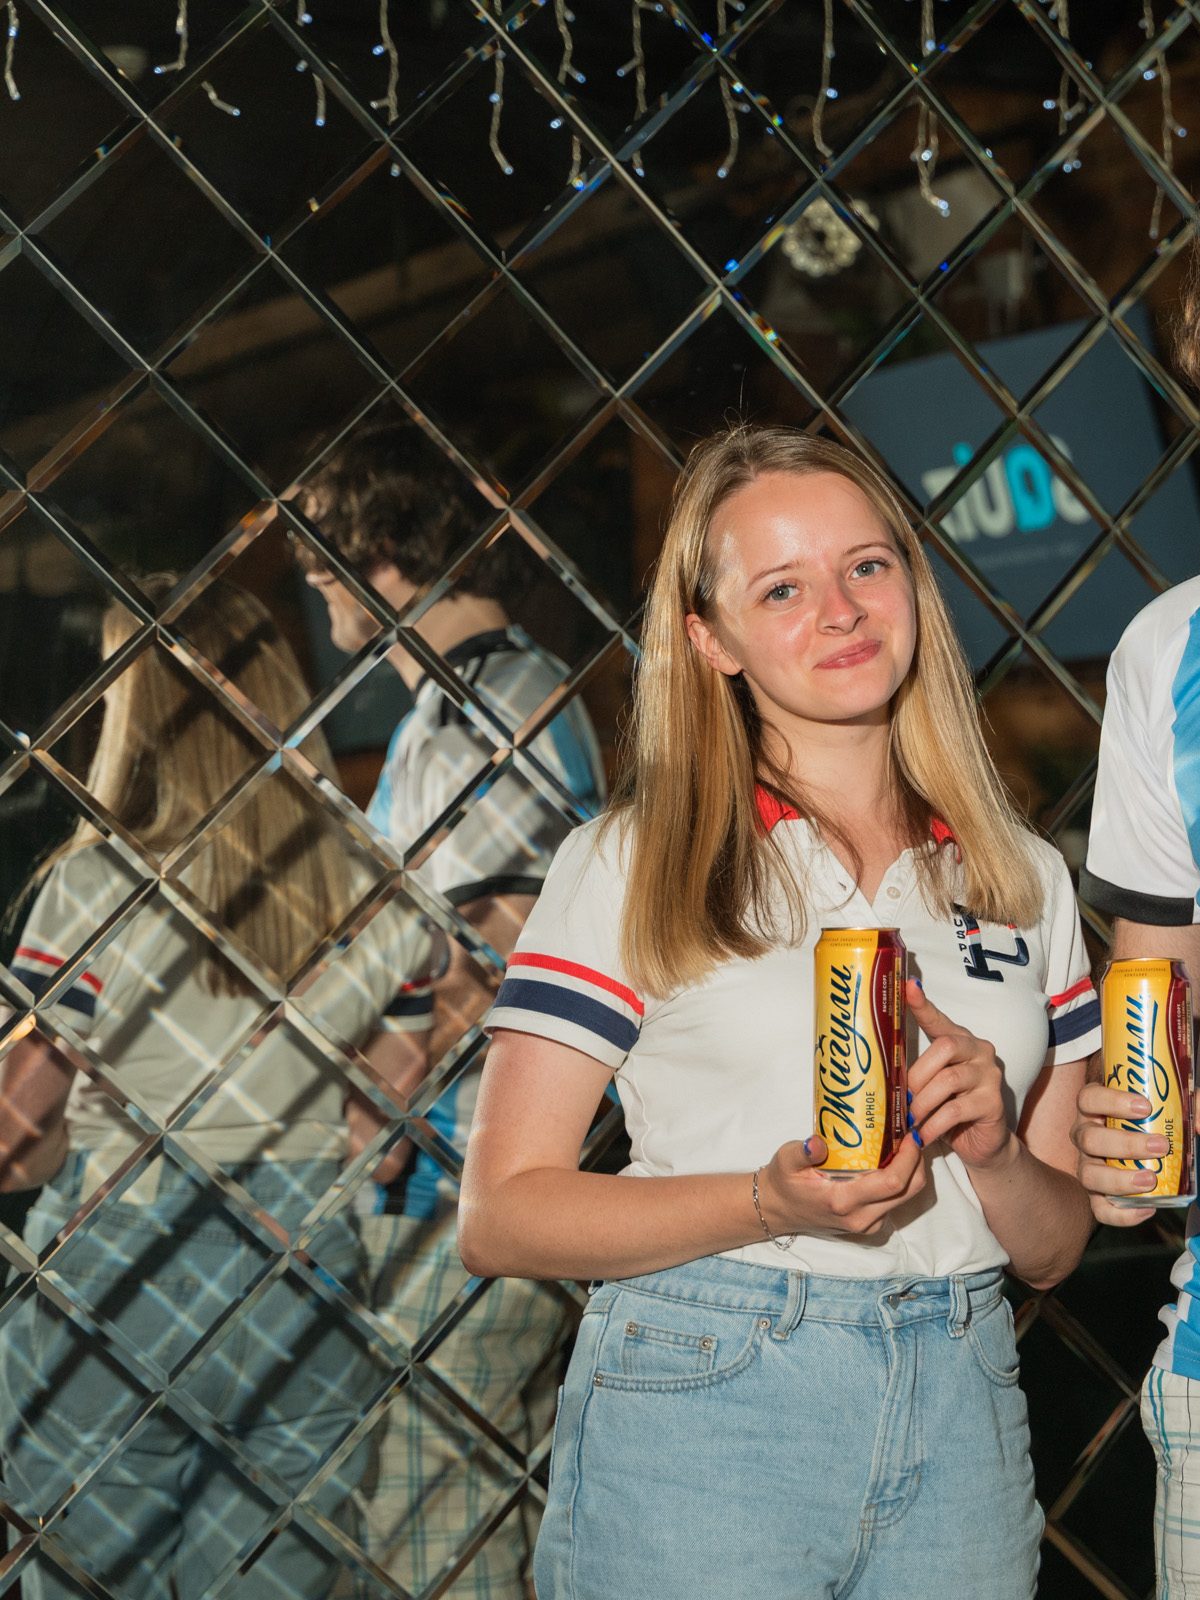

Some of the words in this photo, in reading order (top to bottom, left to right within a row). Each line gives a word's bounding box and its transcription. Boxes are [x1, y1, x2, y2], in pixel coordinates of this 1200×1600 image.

[953, 918, 972, 965] USPA
[819, 964, 872, 1148] Жигули
[865, 1090, 876, 1129] БАРНОЕ
